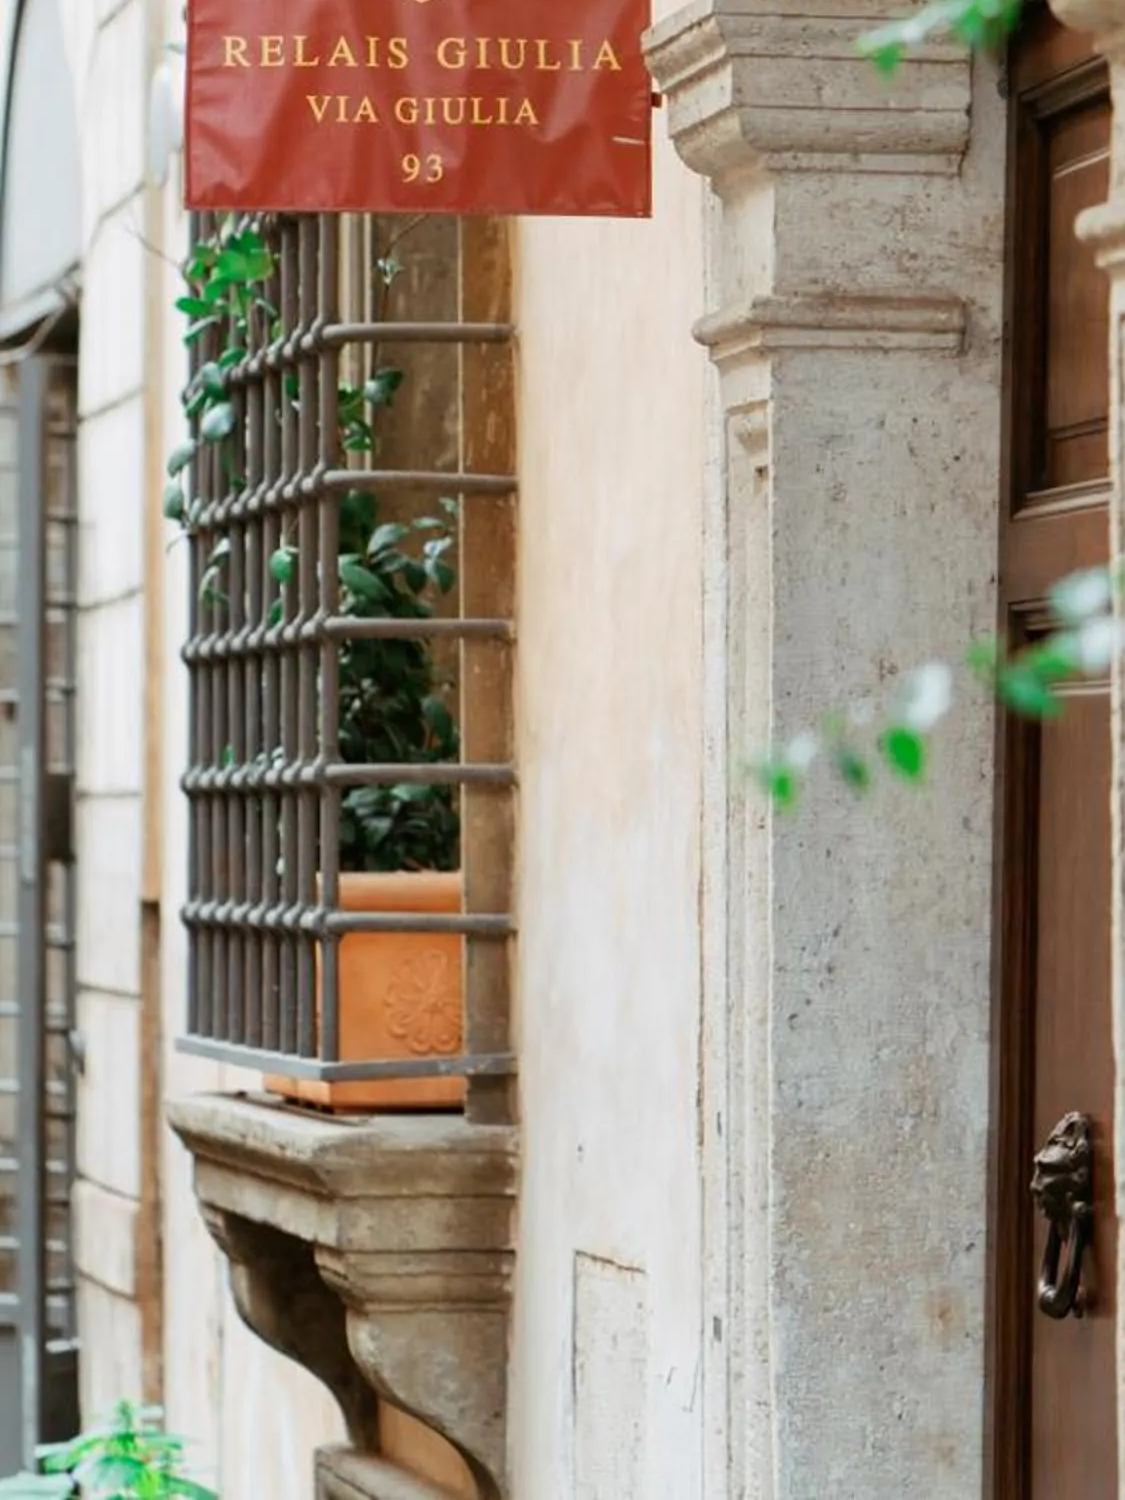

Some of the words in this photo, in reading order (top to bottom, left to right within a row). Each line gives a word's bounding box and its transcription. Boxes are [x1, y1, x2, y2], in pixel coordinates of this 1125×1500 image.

[223, 36, 409, 69] RELAIS
[436, 37, 622, 71] GIULIA
[306, 95, 379, 124] VIA
[394, 97, 540, 125] GIULIA
[401, 154, 444, 183] 93
